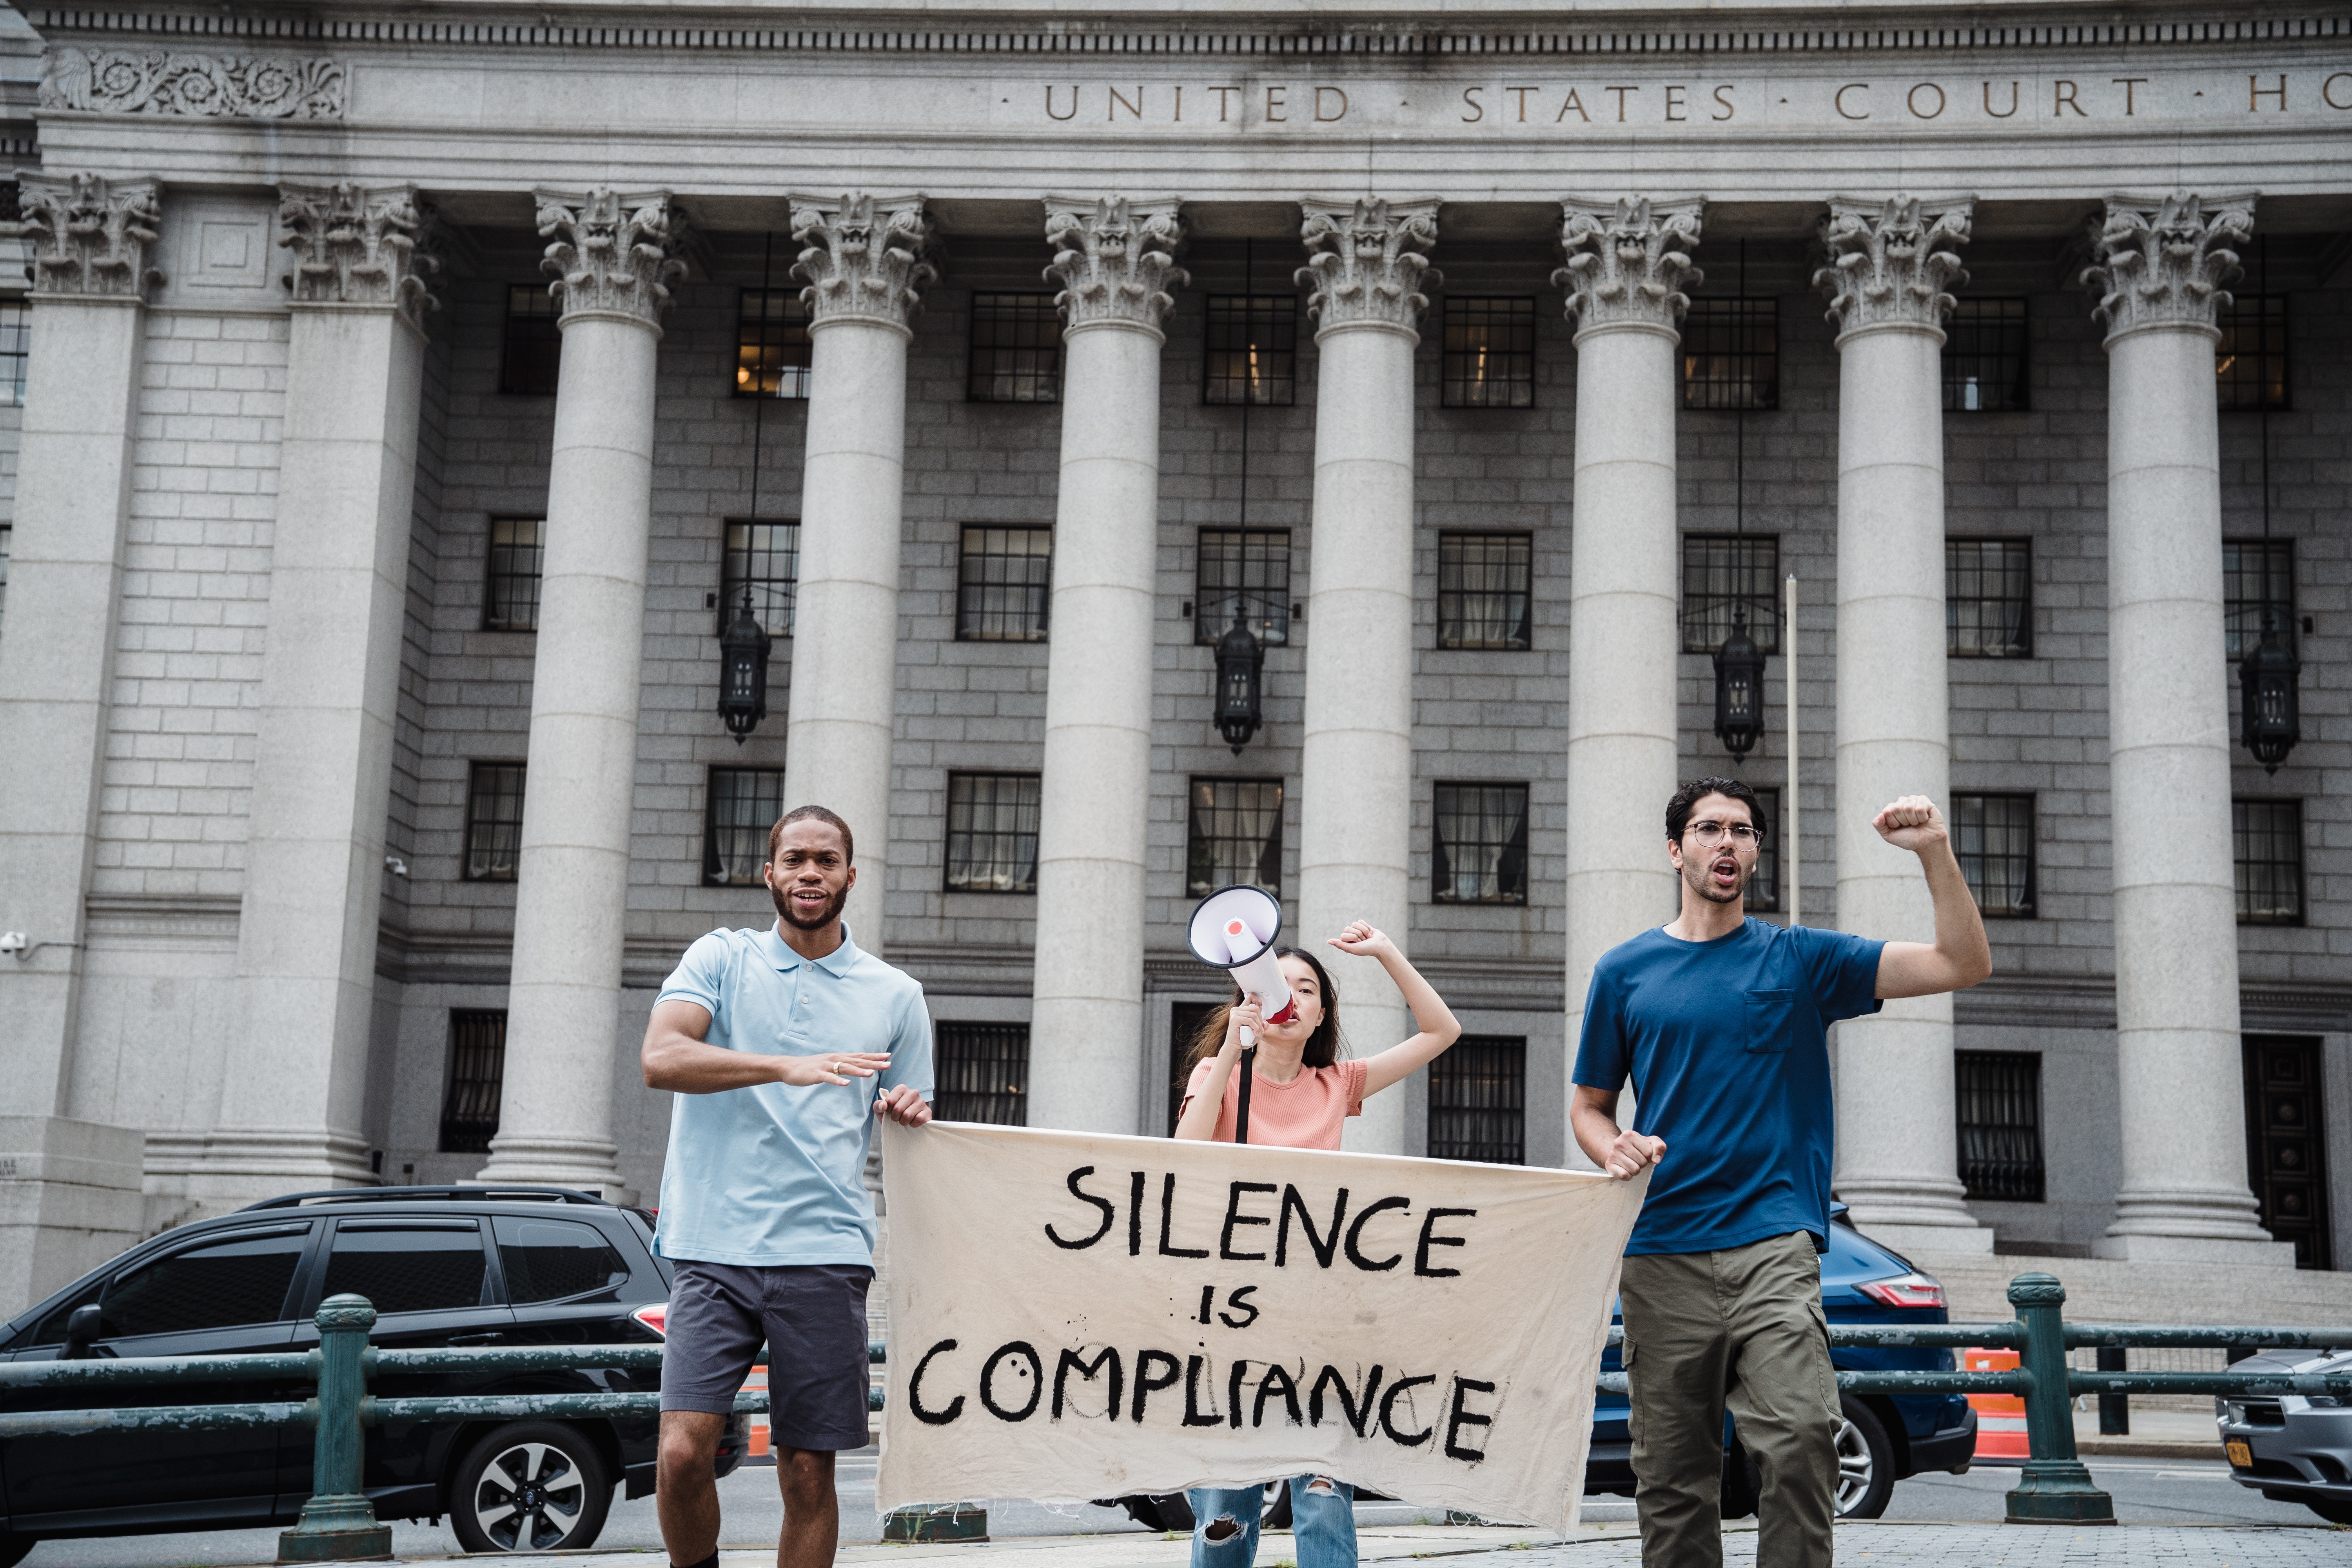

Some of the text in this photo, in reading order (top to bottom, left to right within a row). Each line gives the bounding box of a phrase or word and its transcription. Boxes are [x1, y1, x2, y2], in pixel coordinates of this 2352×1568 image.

[1045, 85, 1348, 122] UNITED
[1461, 85, 1734, 122] STATES
[1835, 78, 2148, 120] COURT
[1044, 1165, 1477, 1278] SILENCE
[1198, 1285, 1259, 1329] IS
[909, 1338, 1496, 1464] COMPLIANCE
